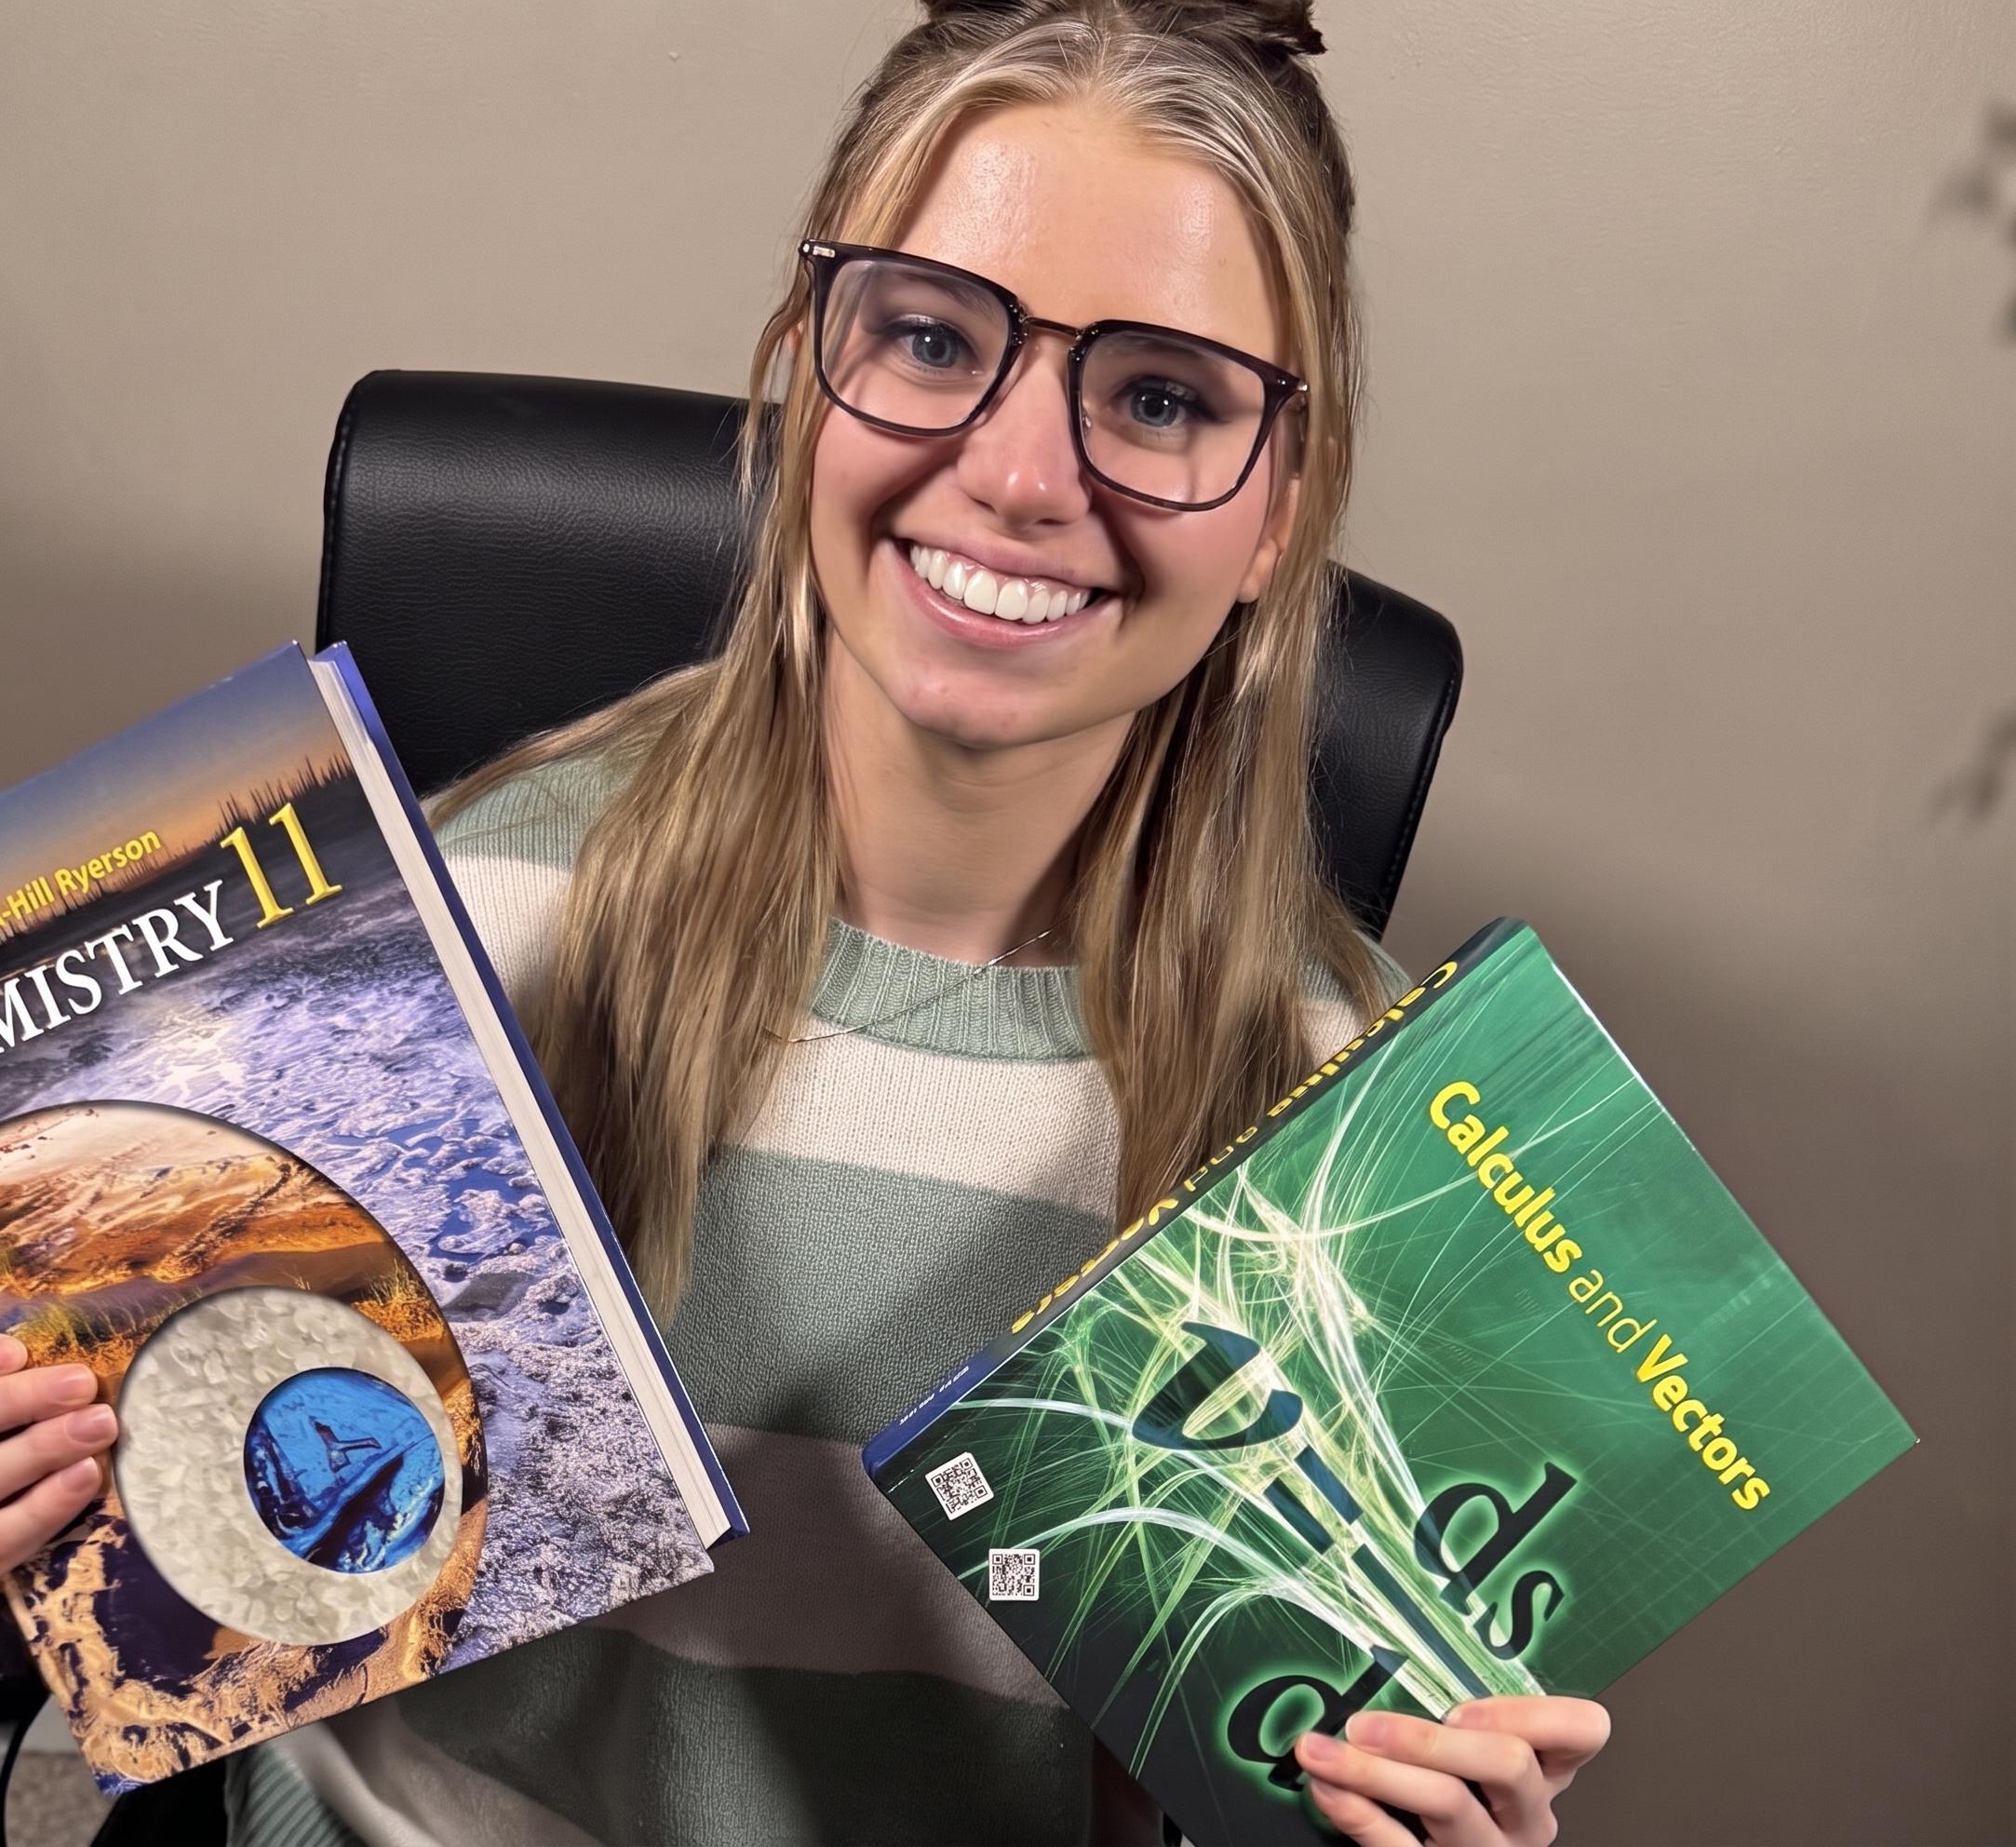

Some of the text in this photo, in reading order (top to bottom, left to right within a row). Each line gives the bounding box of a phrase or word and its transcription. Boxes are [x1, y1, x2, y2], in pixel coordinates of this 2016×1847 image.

[54, 830, 162, 894] Ryerson
[221, 802, 342, 930] 11
[1429, 1080, 1771, 1511] Calculus and Vectors
[1413, 1461, 1579, 1661] ds
[1227, 1643, 1409, 1792] d
